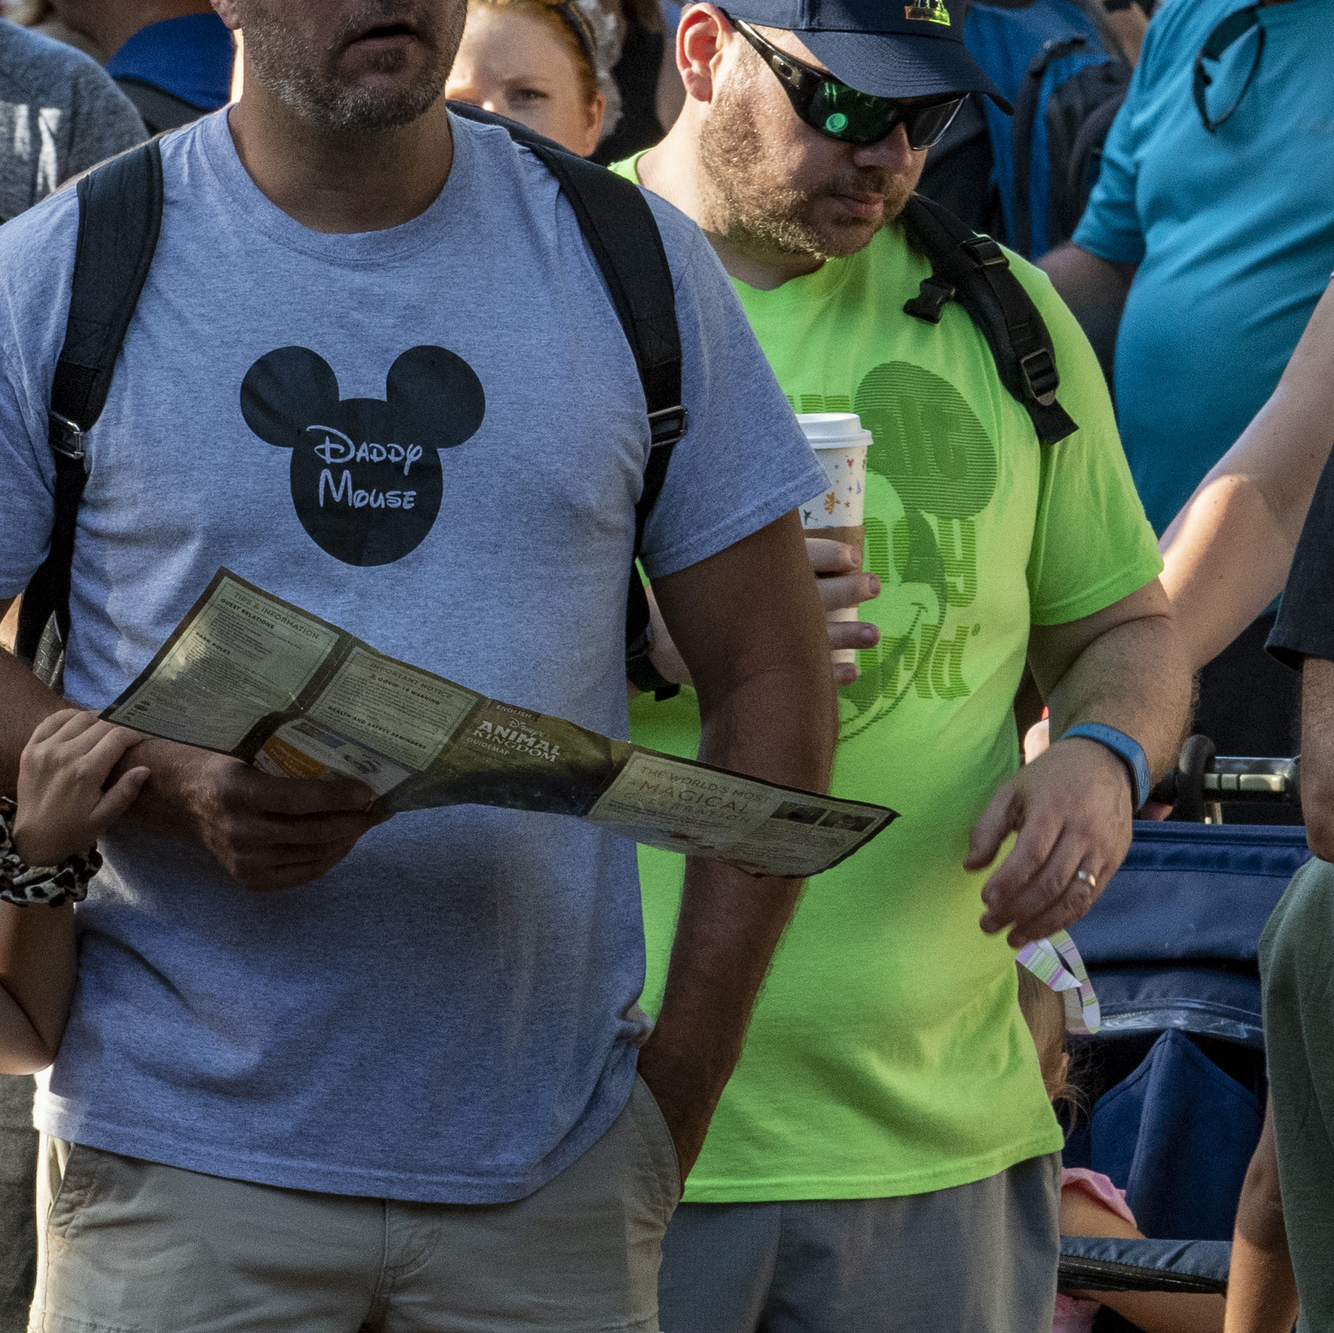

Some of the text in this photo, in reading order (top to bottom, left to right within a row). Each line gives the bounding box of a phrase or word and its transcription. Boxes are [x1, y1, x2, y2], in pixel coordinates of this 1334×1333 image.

[220, 598, 275, 630] GUEST RELATIONS
[234, 592, 251, 606] TIPS
[261, 607, 320, 640] INFORMATION
[411, 690, 440, 705] WARNING
[495, 704, 533, 719] ENGLISH
[328, 706, 427, 750] HEALTH AND SAFETY REMINDERS
[477, 720, 561, 756] ANIMAL
[466, 736, 511, 756] GUIDEMAP
[472, 729, 557, 763] KINGDOM
[641, 766, 666, 778] THE
[669, 772, 730, 794] WORLD'S
[638, 780, 751, 815] MAGICAL
